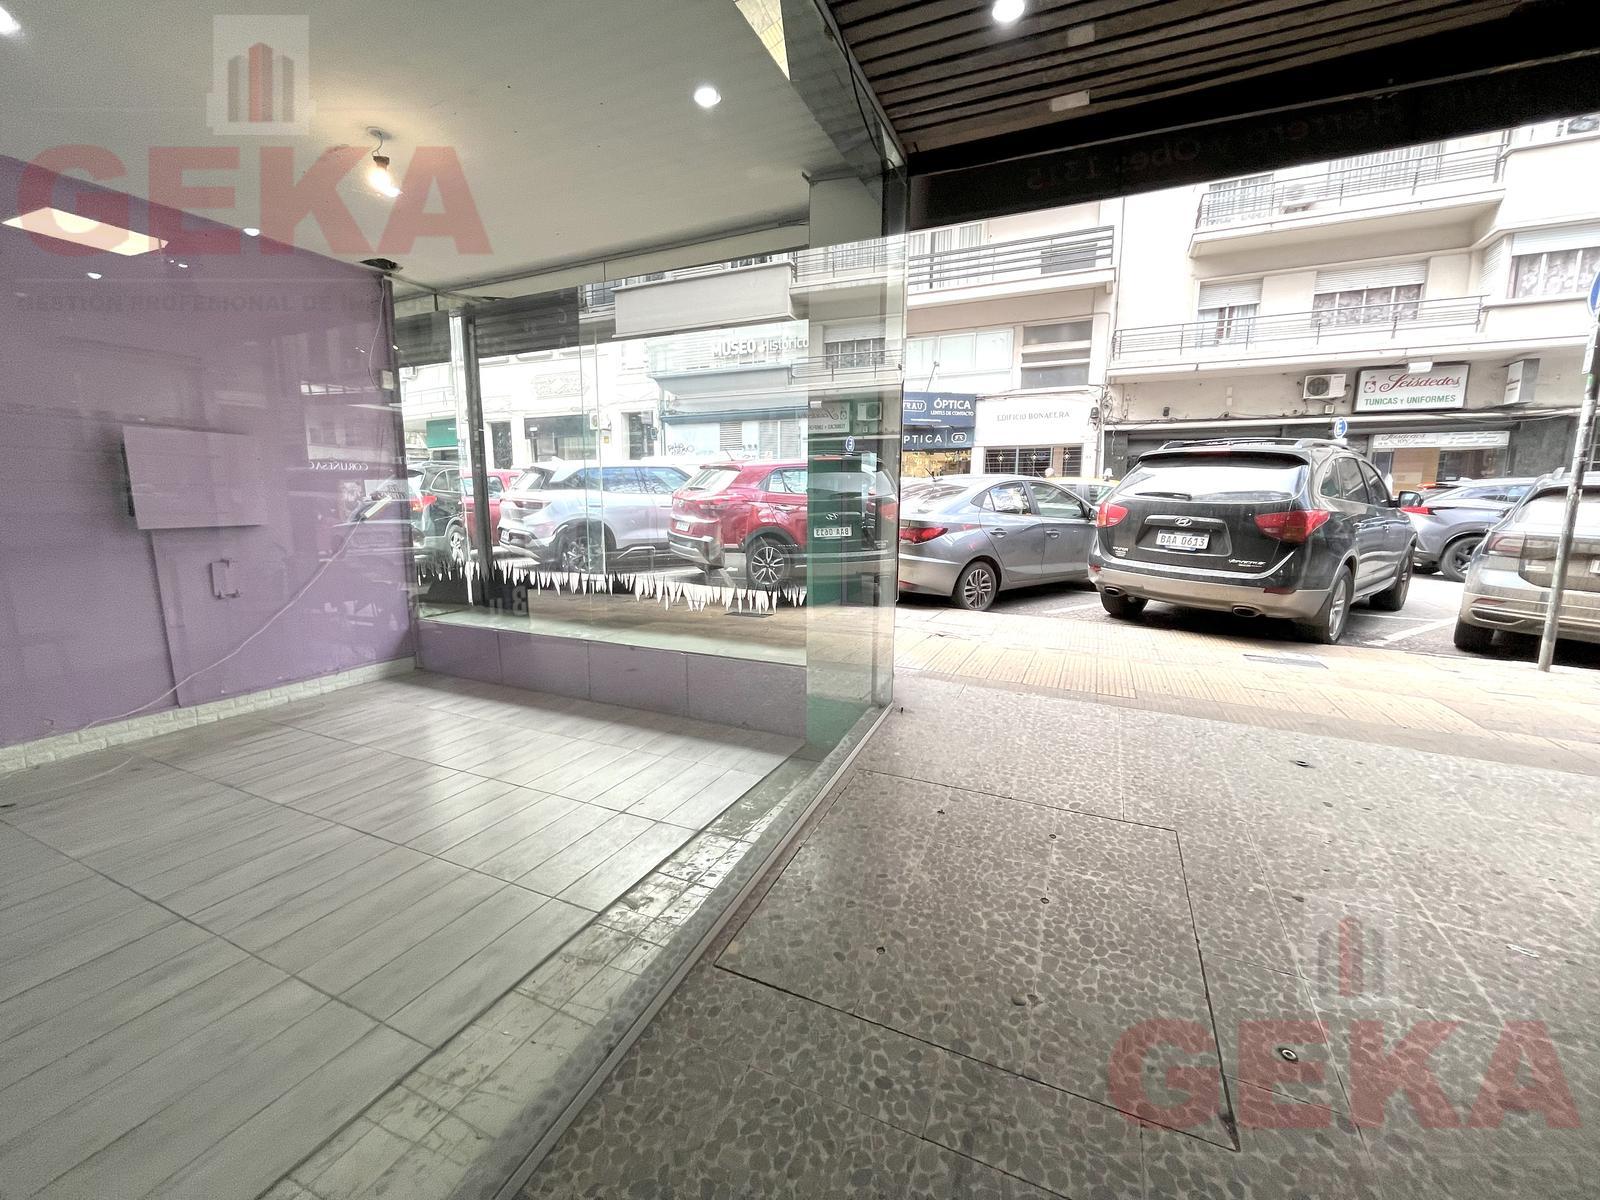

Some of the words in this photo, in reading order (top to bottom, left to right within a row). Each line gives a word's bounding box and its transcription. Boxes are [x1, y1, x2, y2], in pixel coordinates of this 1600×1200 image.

[712, 338, 756, 356] MUSEO
[1379, 373, 1462, 393] Seisdedos
[933, 397, 971, 410] ÓPTICA
[1365, 397, 1398, 407] TUNICAS
[1406, 394, 1456, 405] UNIFORMES
[997, 413, 1027, 422] EDIFICIO
[1160, 534, 1177, 544] BAA
[1181, 536, 1205, 547] 0613
